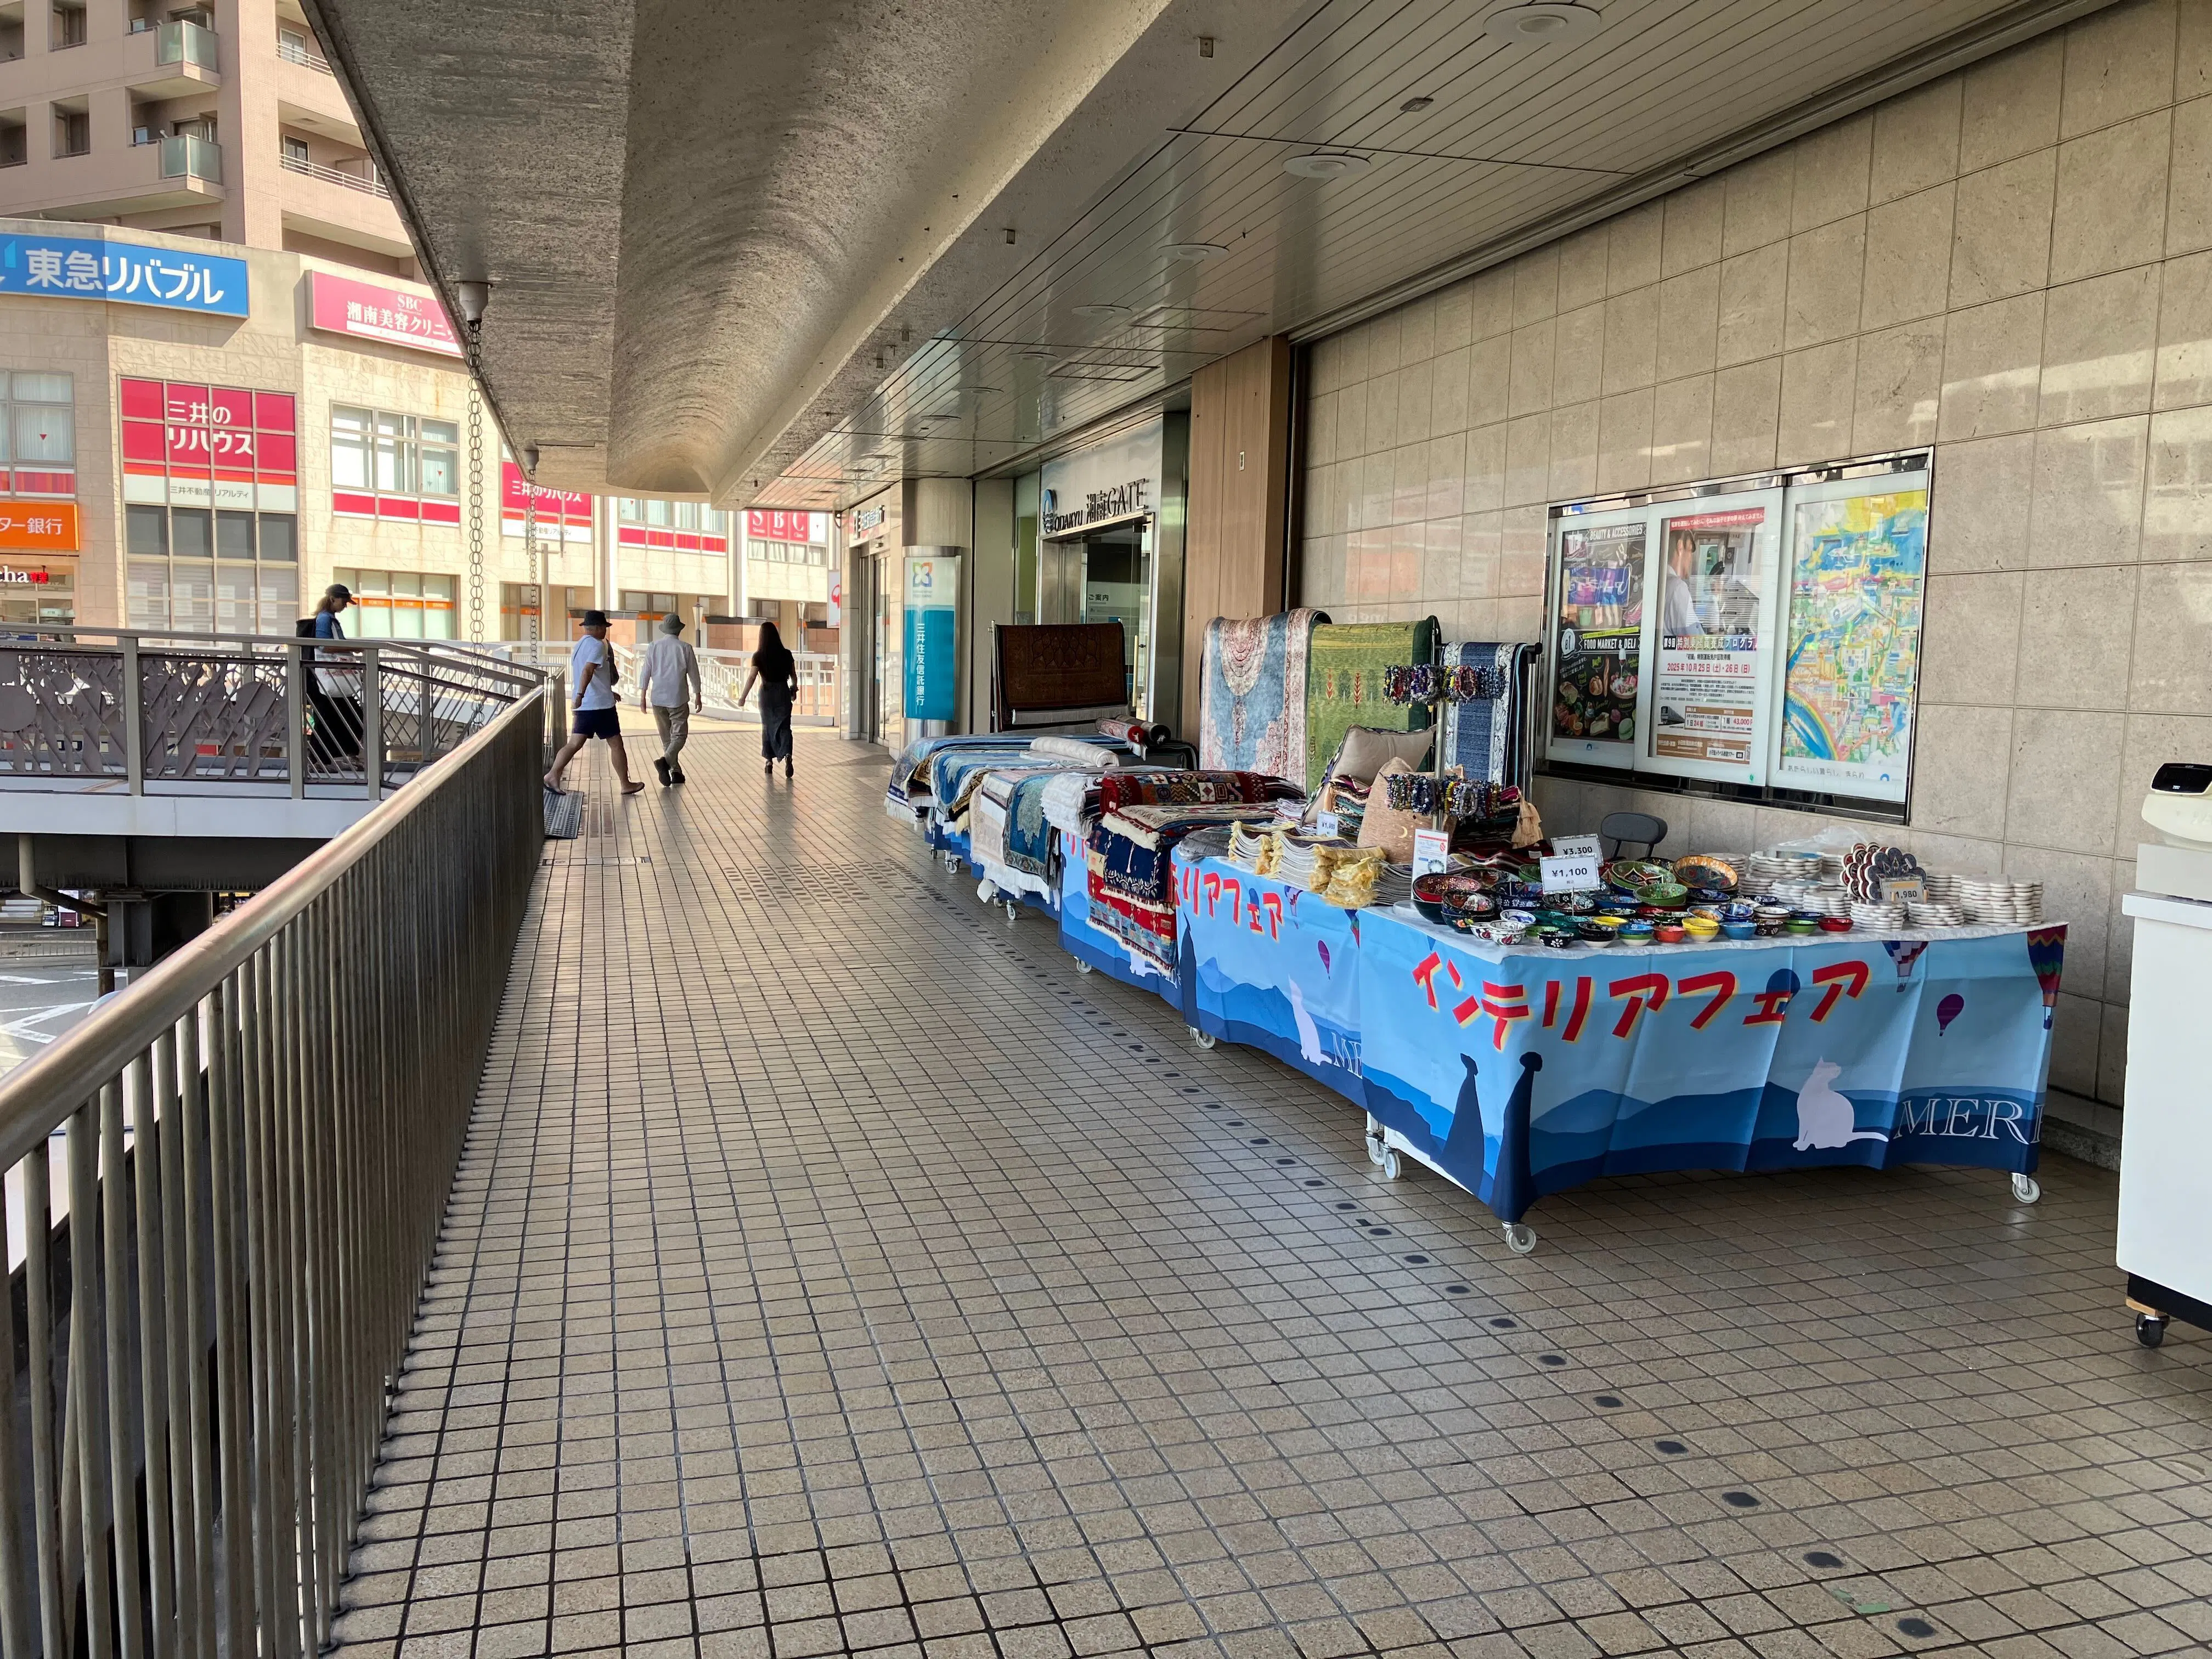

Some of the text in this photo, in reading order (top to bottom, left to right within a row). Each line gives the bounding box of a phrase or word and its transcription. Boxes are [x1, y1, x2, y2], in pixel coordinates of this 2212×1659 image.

[25, 248, 224, 304] 東急リバブル
[397, 295, 422, 312] SBC
[168, 400, 232, 425] 三井の
[168, 427, 253, 455] リハウス
[170, 486, 249, 498] 三井不動産リアルティ
[1054, 478, 1146, 532] ODAKYU 湘南GATE
[0, 517, 63, 535] ター銀行
[1590, 524, 1643, 540] BEAUTY & ACCESSORIES
[1565, 635, 1571, 650] B1
[1584, 639, 1596, 650] FOOD
[1597, 638, 1617, 650] MARKET
[1624, 638, 1637, 649] DELI
[916, 623, 926, 706] 三井住友信託銀行
[1562, 846, 1593, 855] ¥3,300
[1551, 867, 1587, 877] ¥1,100
[1890, 890, 1917, 899] 1,980
[1412, 951, 1871, 1052] インテリアフェア
